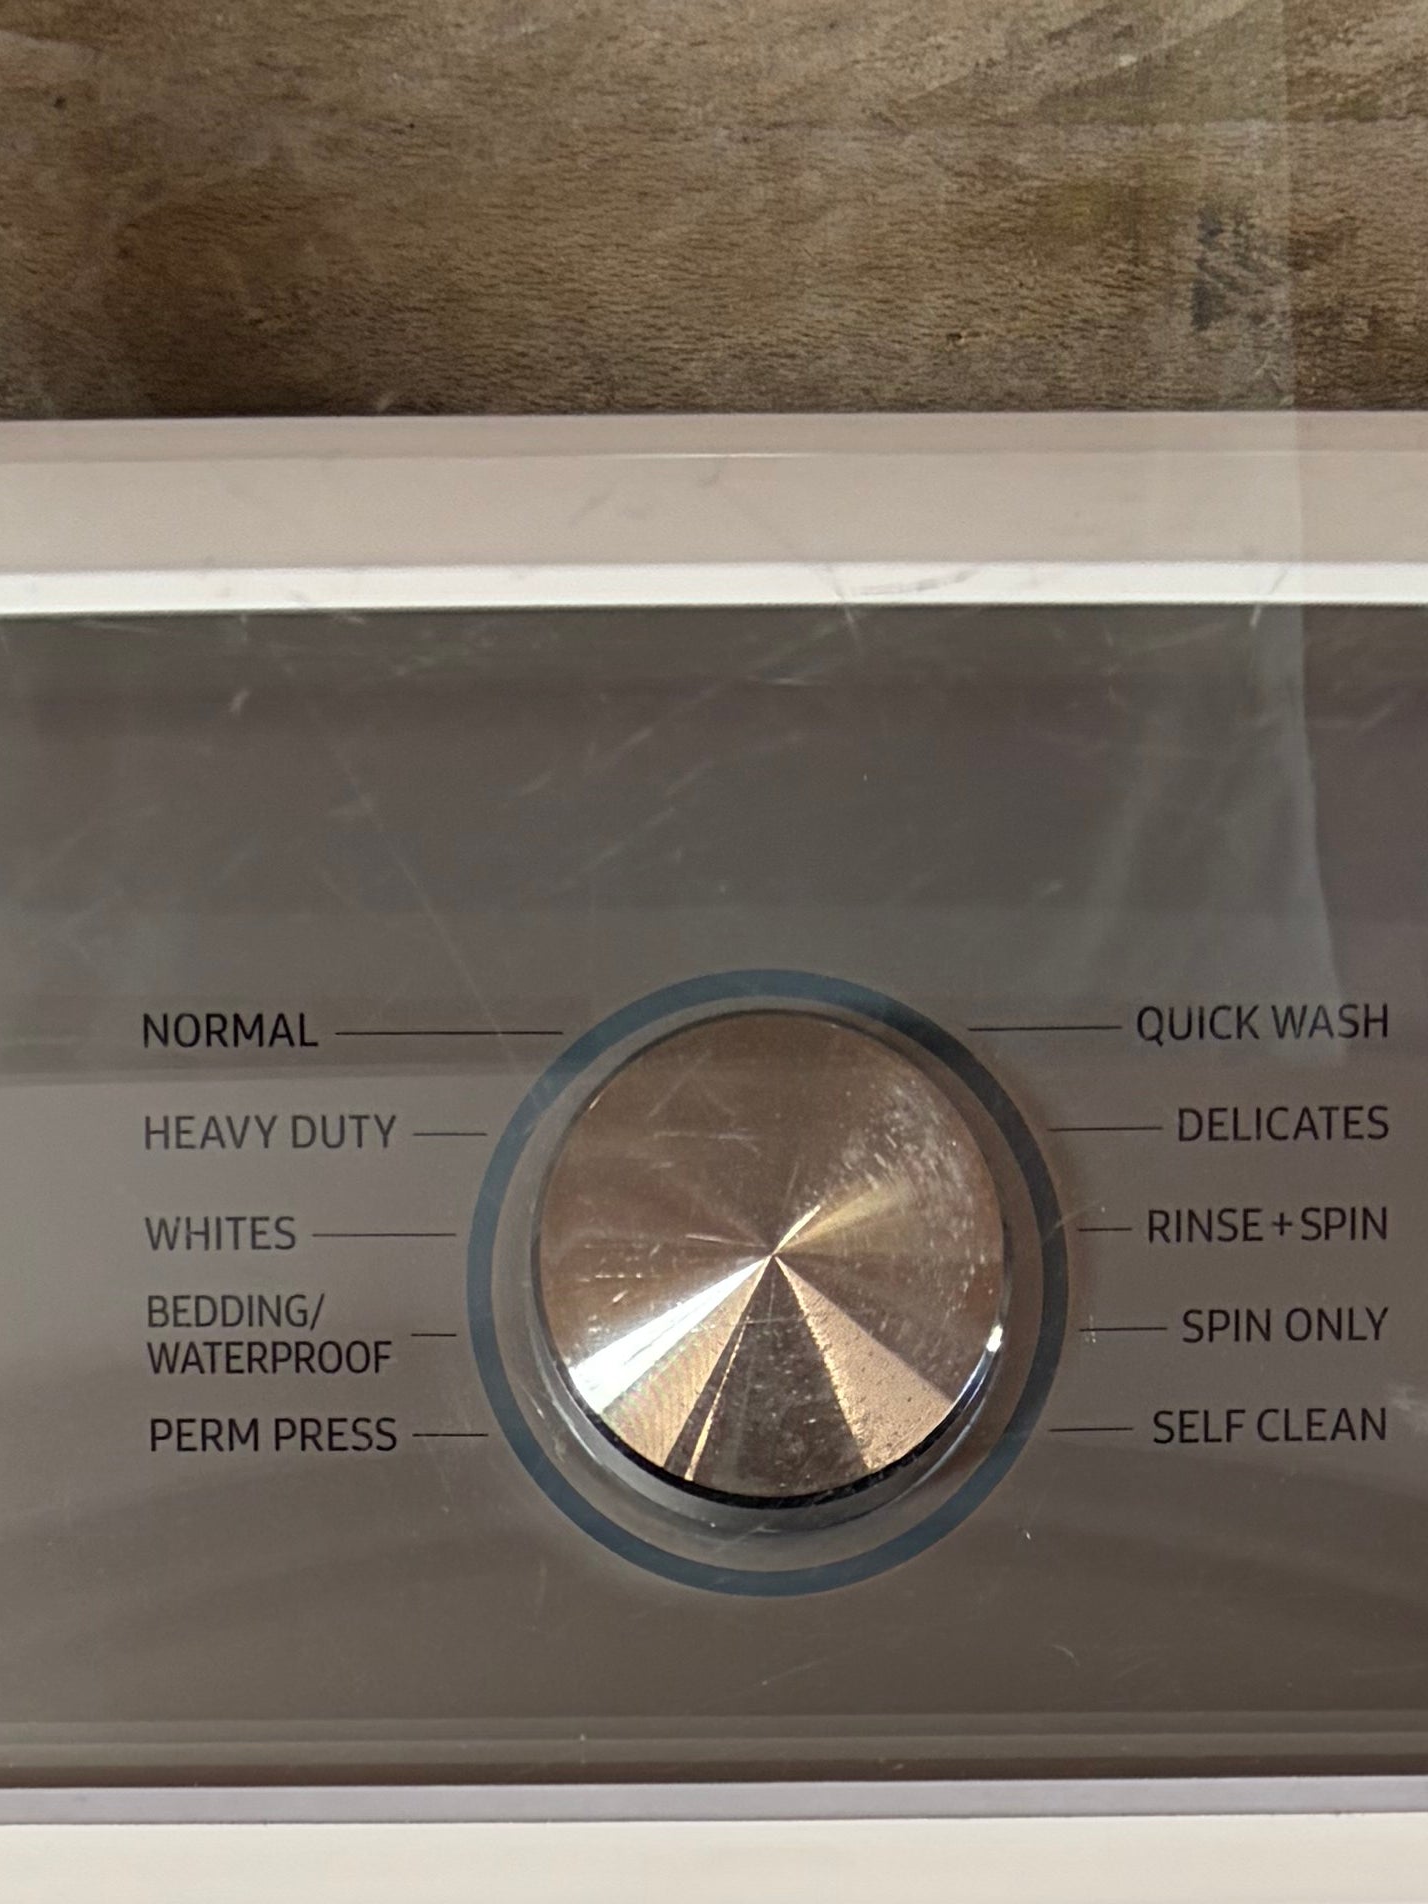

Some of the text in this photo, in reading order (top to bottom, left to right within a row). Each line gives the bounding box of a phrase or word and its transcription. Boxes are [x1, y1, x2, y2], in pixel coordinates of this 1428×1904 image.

[142, 1013, 318, 1048] NORMAL
[1137, 1004, 1388, 1047] QUICK WASH
[144, 1115, 396, 1149] HEAVY DUTY
[1178, 1106, 1388, 1141] DELICATES
[145, 1216, 296, 1250] WHITES
[147, 1294, 325, 1330] BEDDING/
[1182, 1307, 1388, 1343] SPIN ONLY
[148, 1340, 391, 1374] WATERPROOF
[149, 1418, 397, 1452] PERM PRESS
[1152, 1408, 1386, 1444] SELF CLEAN
